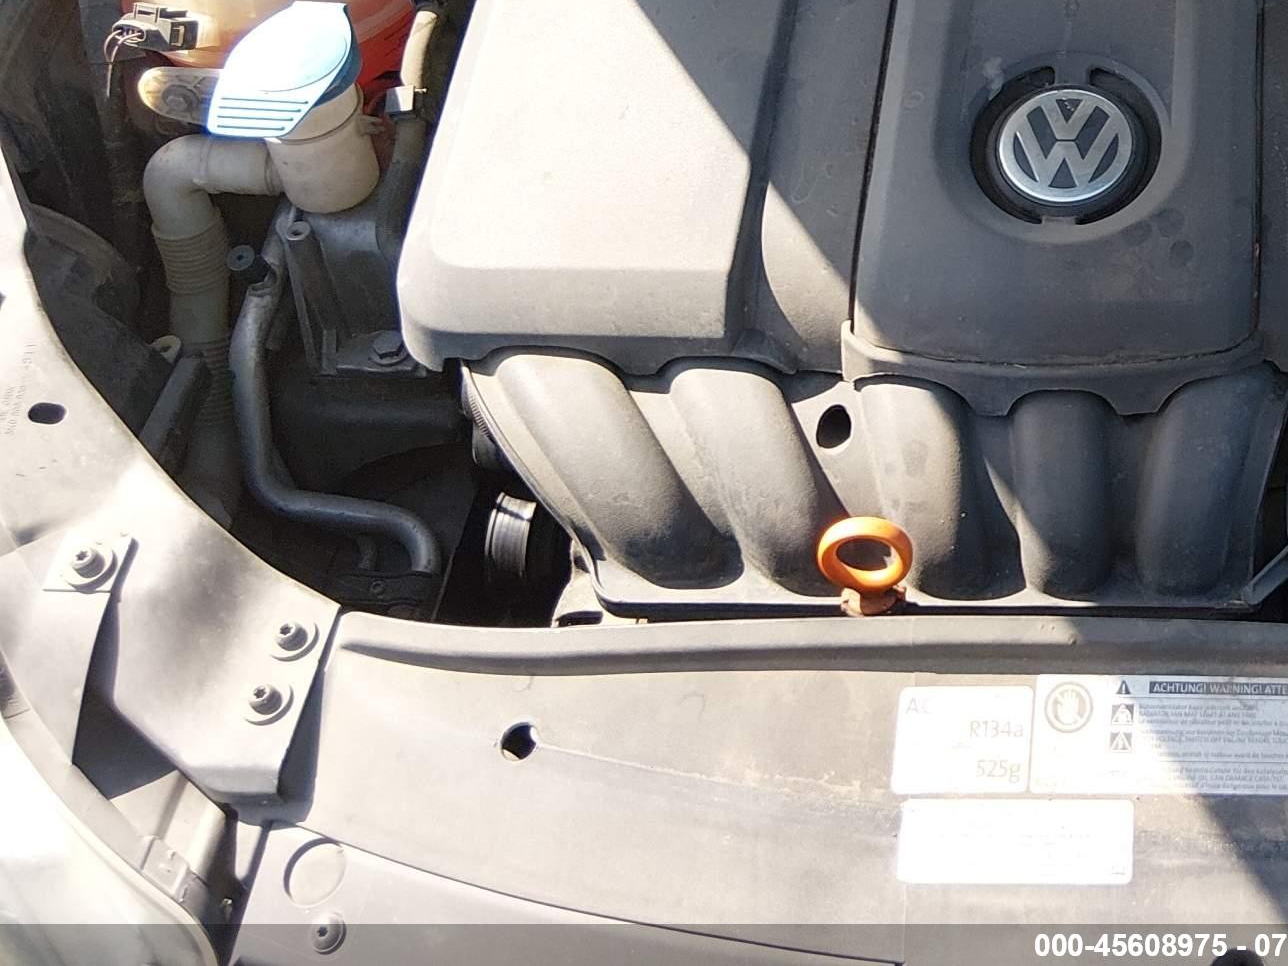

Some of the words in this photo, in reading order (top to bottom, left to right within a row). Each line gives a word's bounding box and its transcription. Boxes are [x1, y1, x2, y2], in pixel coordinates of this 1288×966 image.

[1152, 682, 1207, 694] ACHTUNG!
[1209, 683, 1262, 694] WARNING!
[969, 719, 1025, 739] R134a
[975, 758, 1022, 784] 525g
